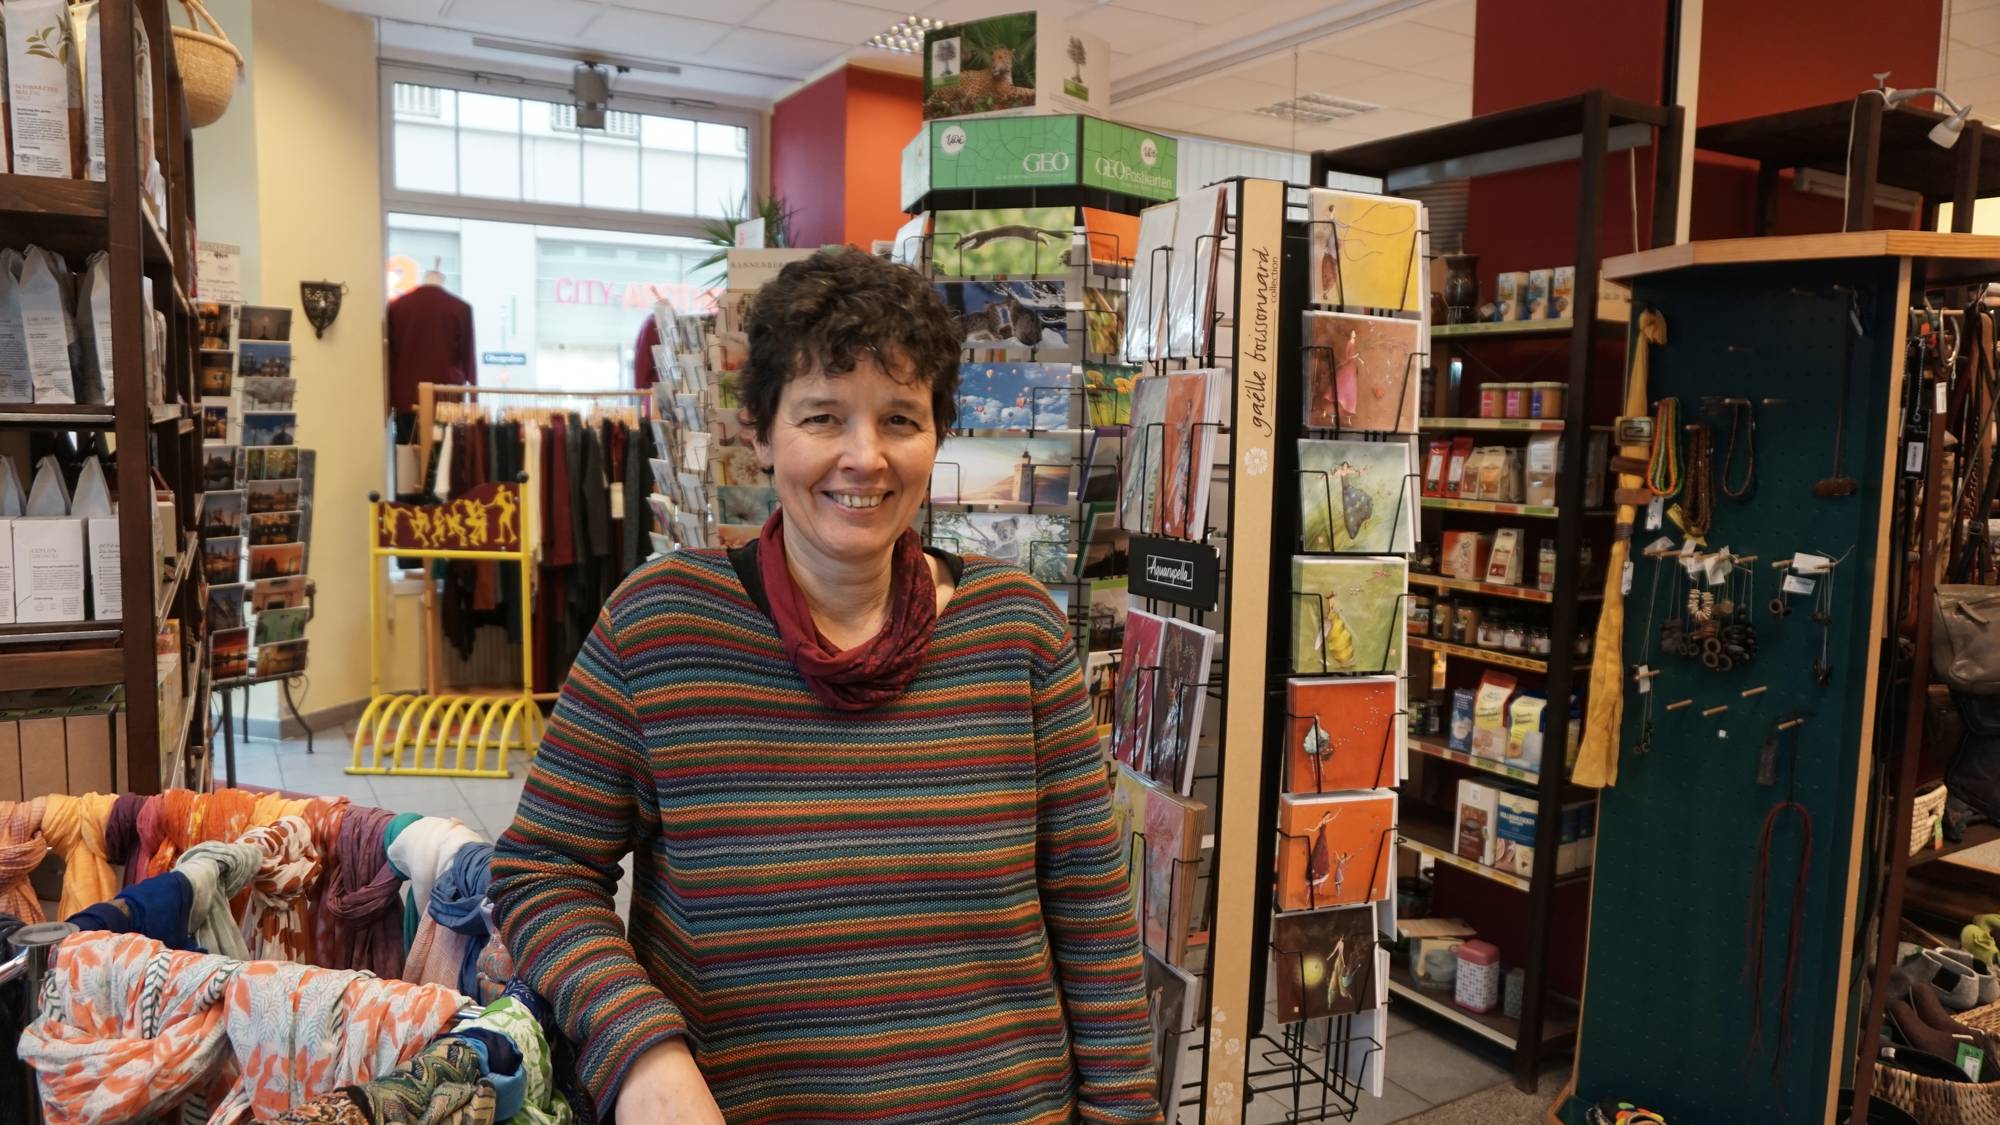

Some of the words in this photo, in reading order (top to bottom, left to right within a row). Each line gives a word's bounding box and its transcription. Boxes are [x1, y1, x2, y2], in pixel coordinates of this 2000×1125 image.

[1022, 151, 1070, 173] GEO
[1244, 245, 1271, 363] boissonnard
[1269, 256, 1279, 304] collection
[1244, 370, 1273, 438] gaëlle
